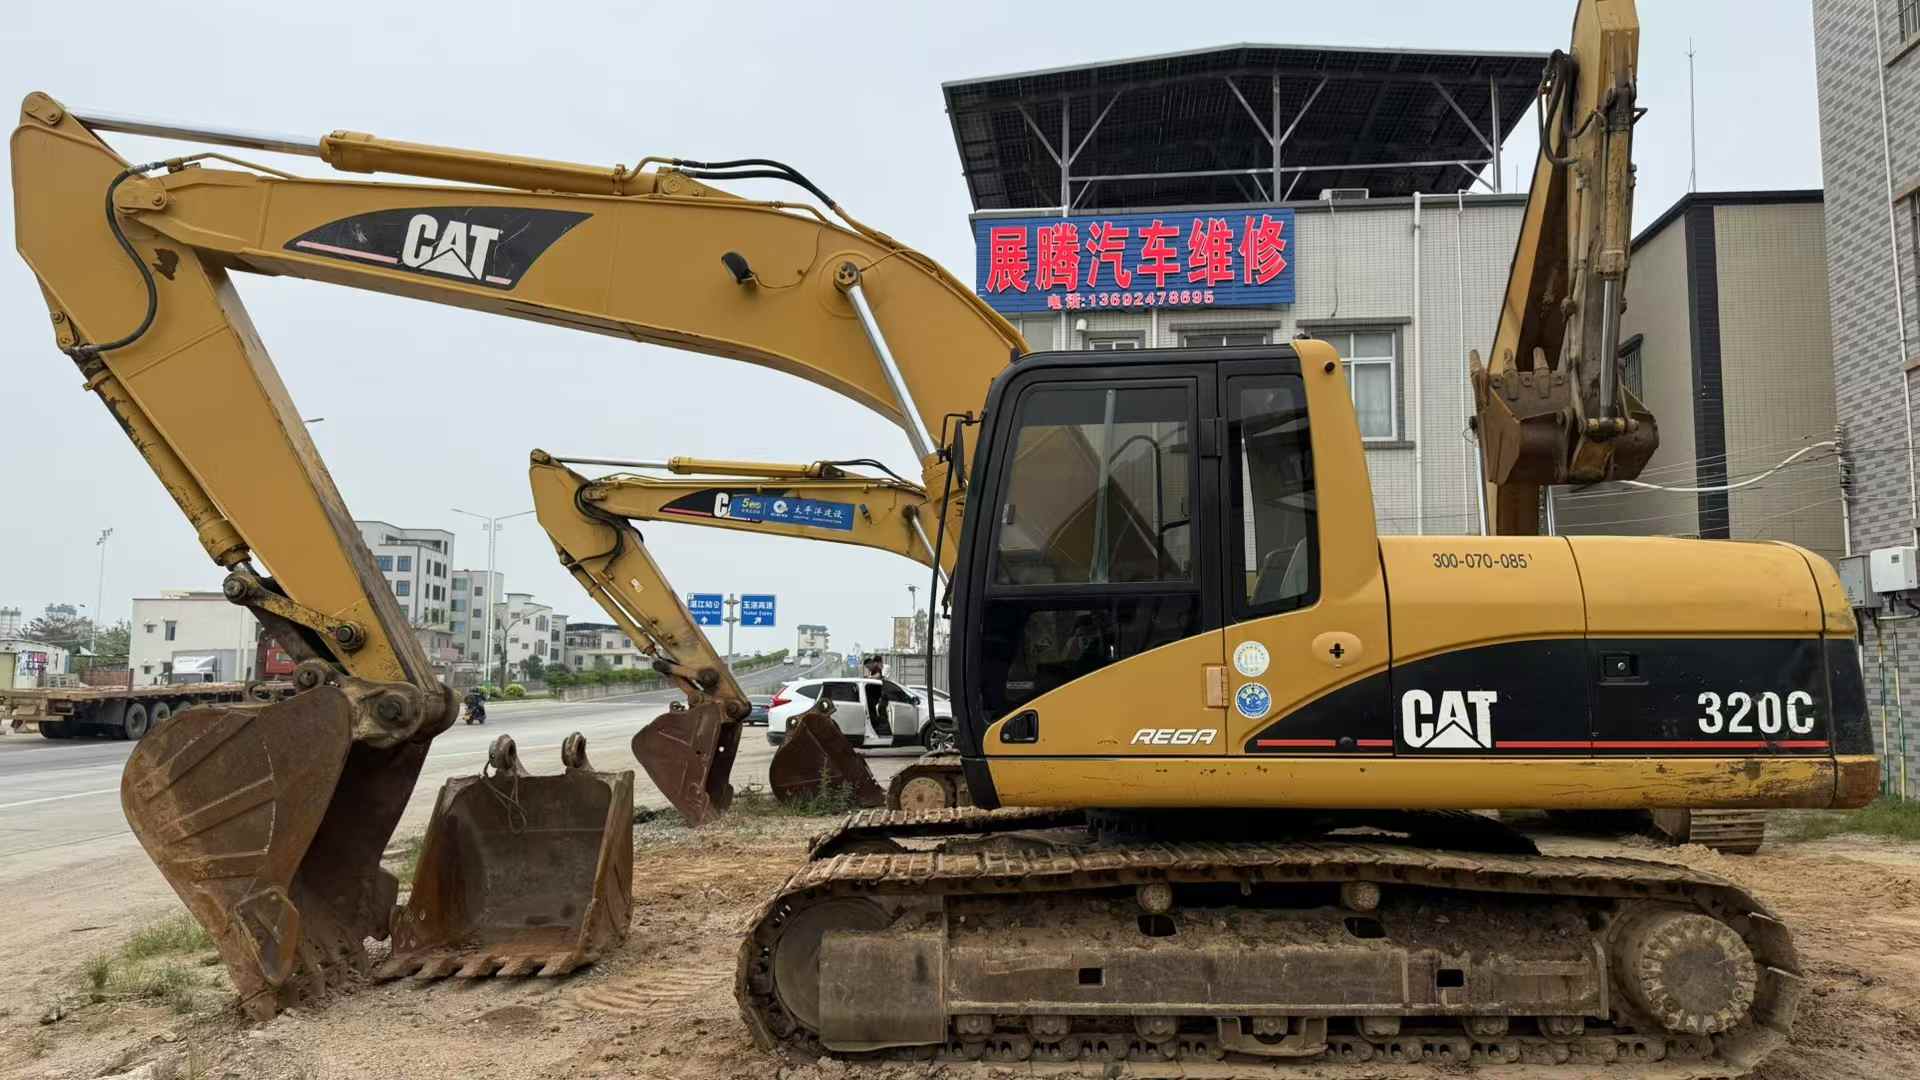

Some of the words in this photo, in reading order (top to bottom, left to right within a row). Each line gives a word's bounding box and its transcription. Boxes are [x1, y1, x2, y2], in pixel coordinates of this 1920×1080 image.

[402, 214, 501, 280] CAT
[986, 214, 1288, 292] 展腾汽车维修
[1130, 728, 1218, 745] REGA
[1401, 689, 1498, 749] CAT
[1697, 690, 1815, 735] 320C
